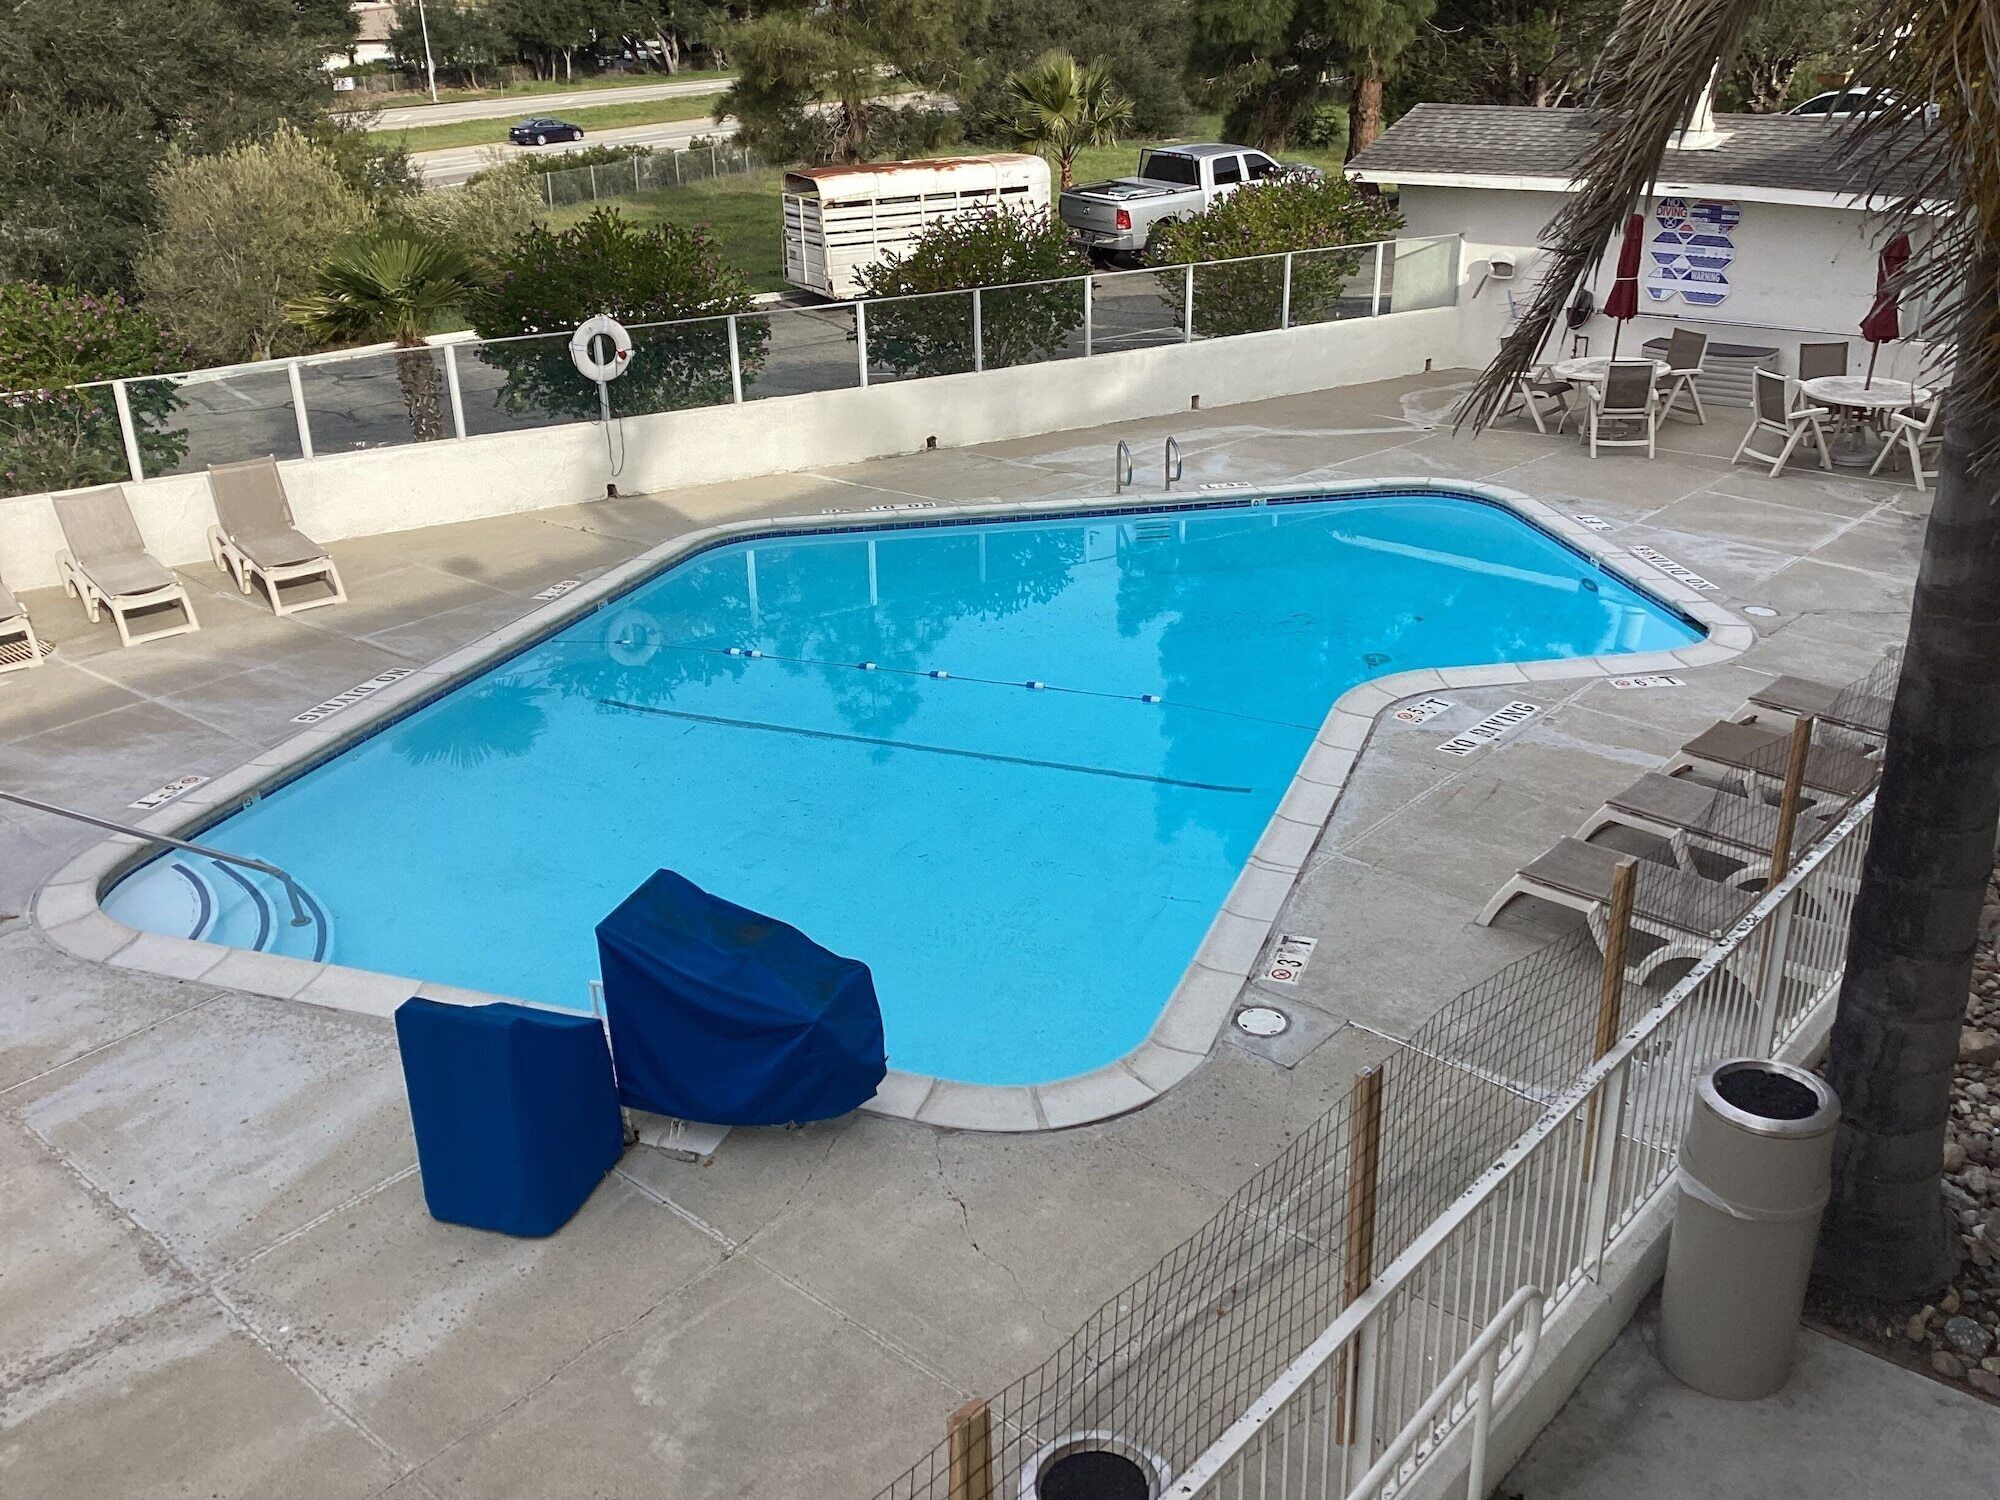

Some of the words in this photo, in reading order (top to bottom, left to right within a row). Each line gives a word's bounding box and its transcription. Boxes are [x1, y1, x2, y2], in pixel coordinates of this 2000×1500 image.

[1666, 197, 1681, 206] NO
[1656, 206, 1688, 218] DIVING
[1690, 270, 1721, 282] WARNING
[375, 669, 411, 682] NO
[297, 686, 376, 721] DIVING
[1439, 738, 1478, 756] NO
[1469, 703, 1536, 739] DIVING
[1276, 959, 1303, 968] 3
